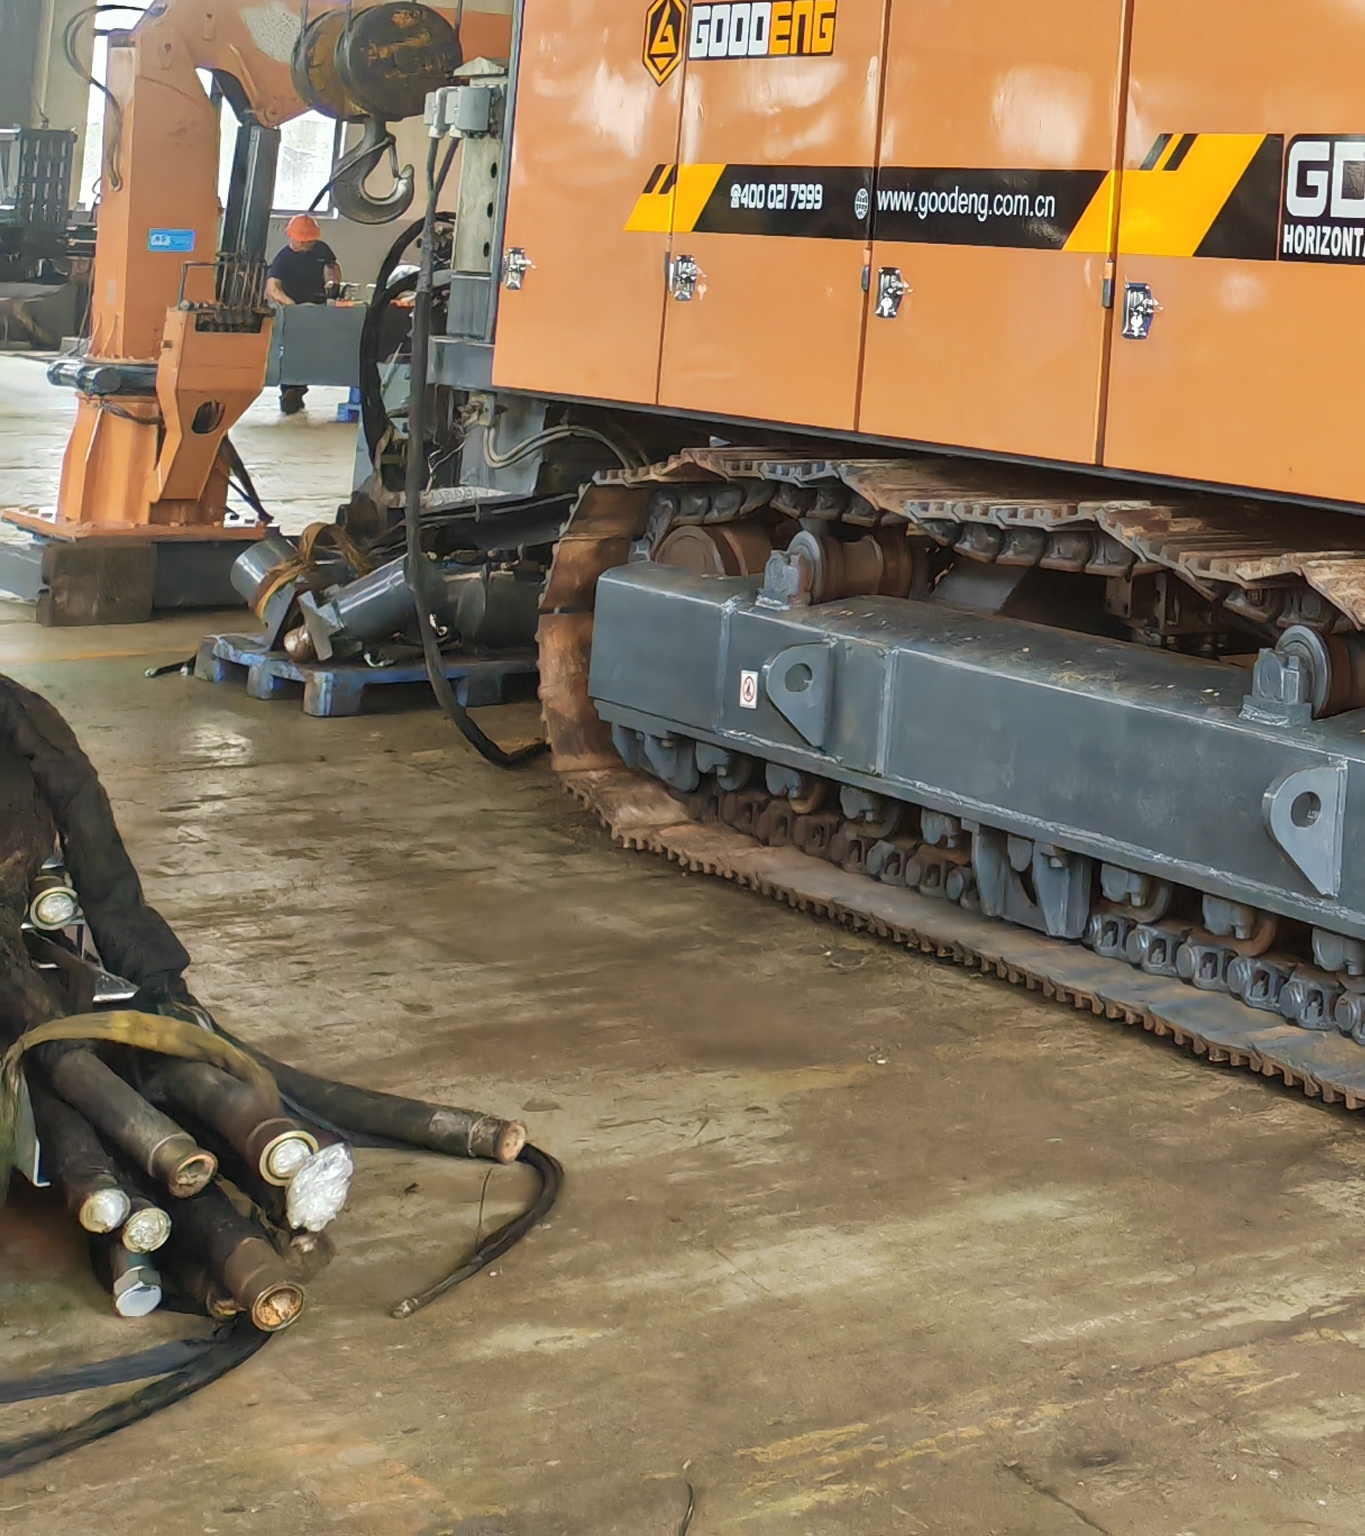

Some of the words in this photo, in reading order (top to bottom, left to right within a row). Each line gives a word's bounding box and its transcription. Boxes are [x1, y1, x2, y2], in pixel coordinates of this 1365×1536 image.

[740, 183, 765, 209] 400
[767, 184, 788, 210] 021
[790, 184, 823, 210] 7999
[877, 185, 1056, 222] www.goodeng.com.cn
